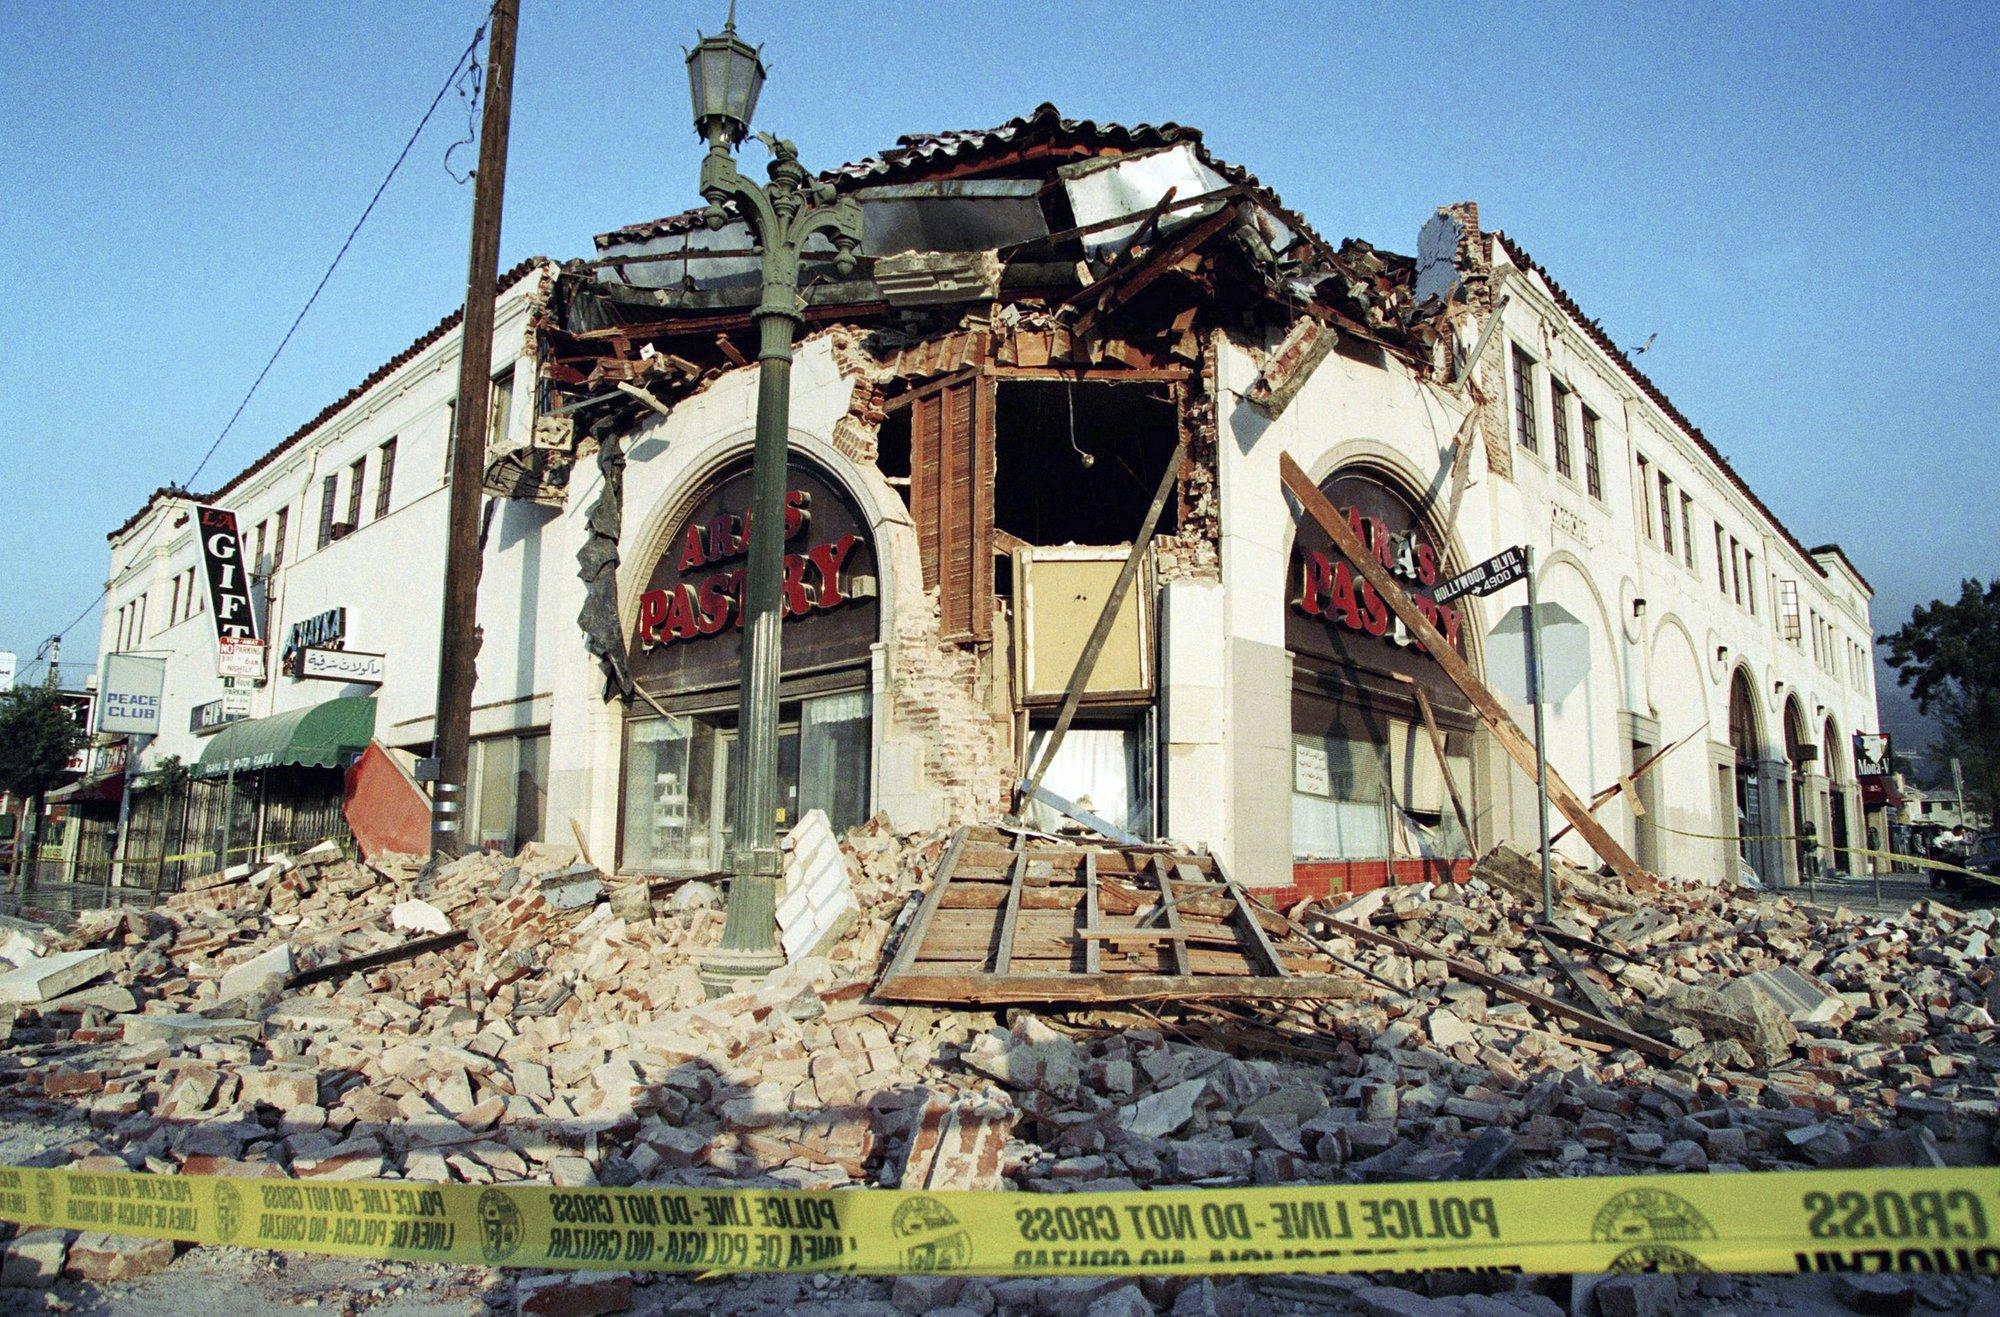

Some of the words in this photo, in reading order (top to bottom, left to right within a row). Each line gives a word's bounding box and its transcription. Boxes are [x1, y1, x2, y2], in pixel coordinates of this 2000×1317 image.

[1434, 567, 1486, 602] HOLLYWOOD
[1491, 551, 1519, 574] BLVD.
[1483, 571, 1512, 590] 4900
[220, 644, 234, 654] NO
[235, 645, 261, 655] PARKING
[225, 688, 251, 696] PARKING
[107, 693, 159, 706] PEACE
[108, 706, 155, 719] CLUB
